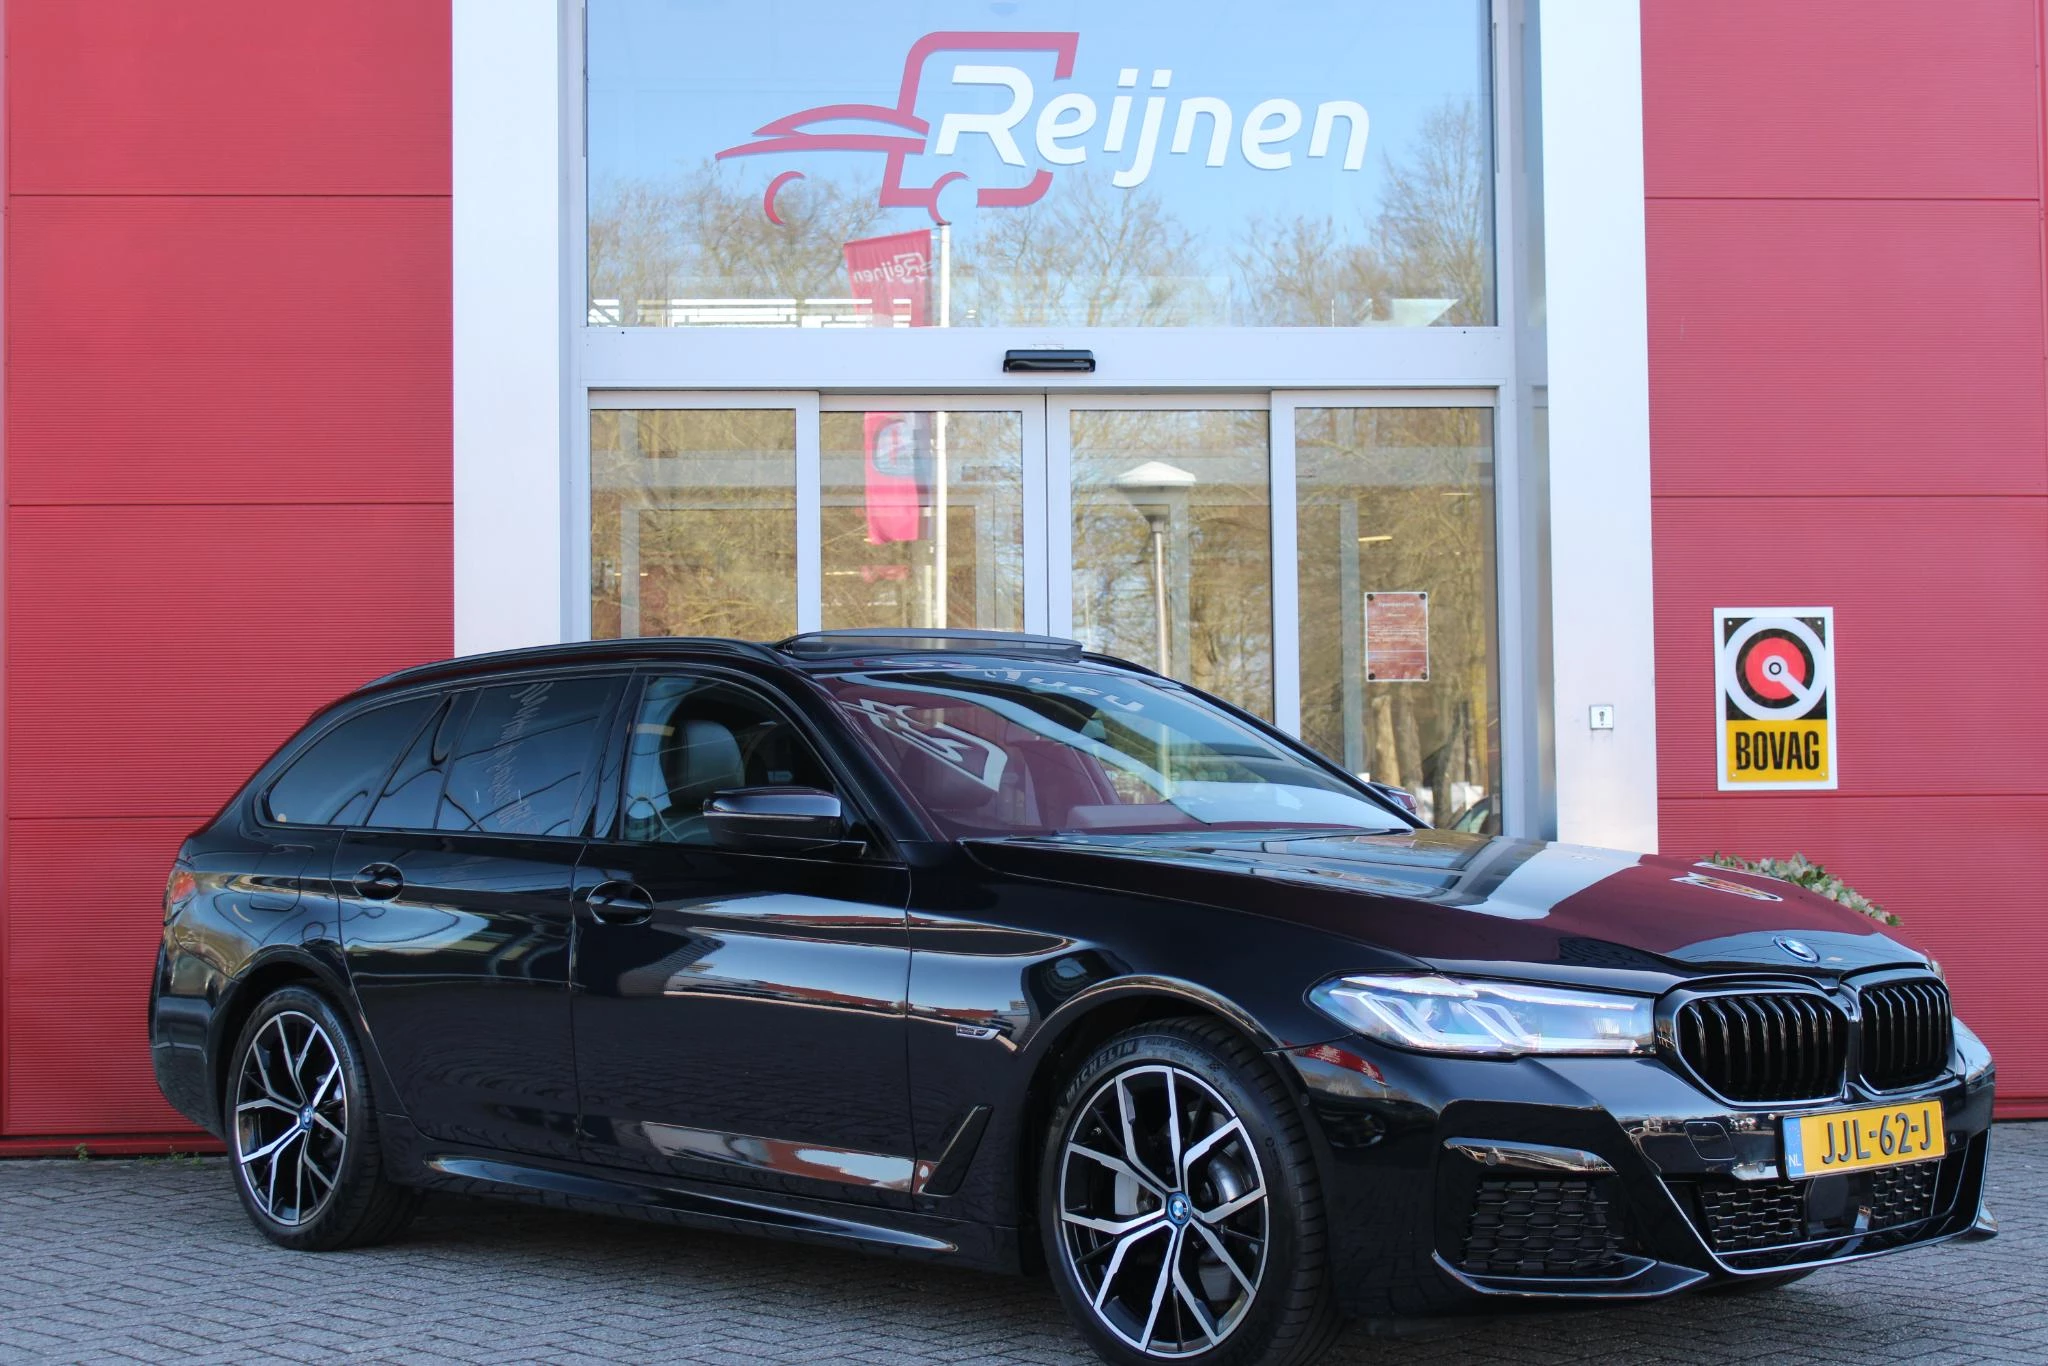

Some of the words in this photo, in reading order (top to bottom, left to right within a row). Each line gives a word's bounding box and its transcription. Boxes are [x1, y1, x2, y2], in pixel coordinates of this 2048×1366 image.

[935, 65, 1369, 188] Reijnen
[1735, 731, 1820, 770] BOVAG
[1066, 1042, 1136, 1102] MICHELIN
[1787, 1153, 1801, 1167] NL
[1822, 1110, 1932, 1164] JJL-62-J
